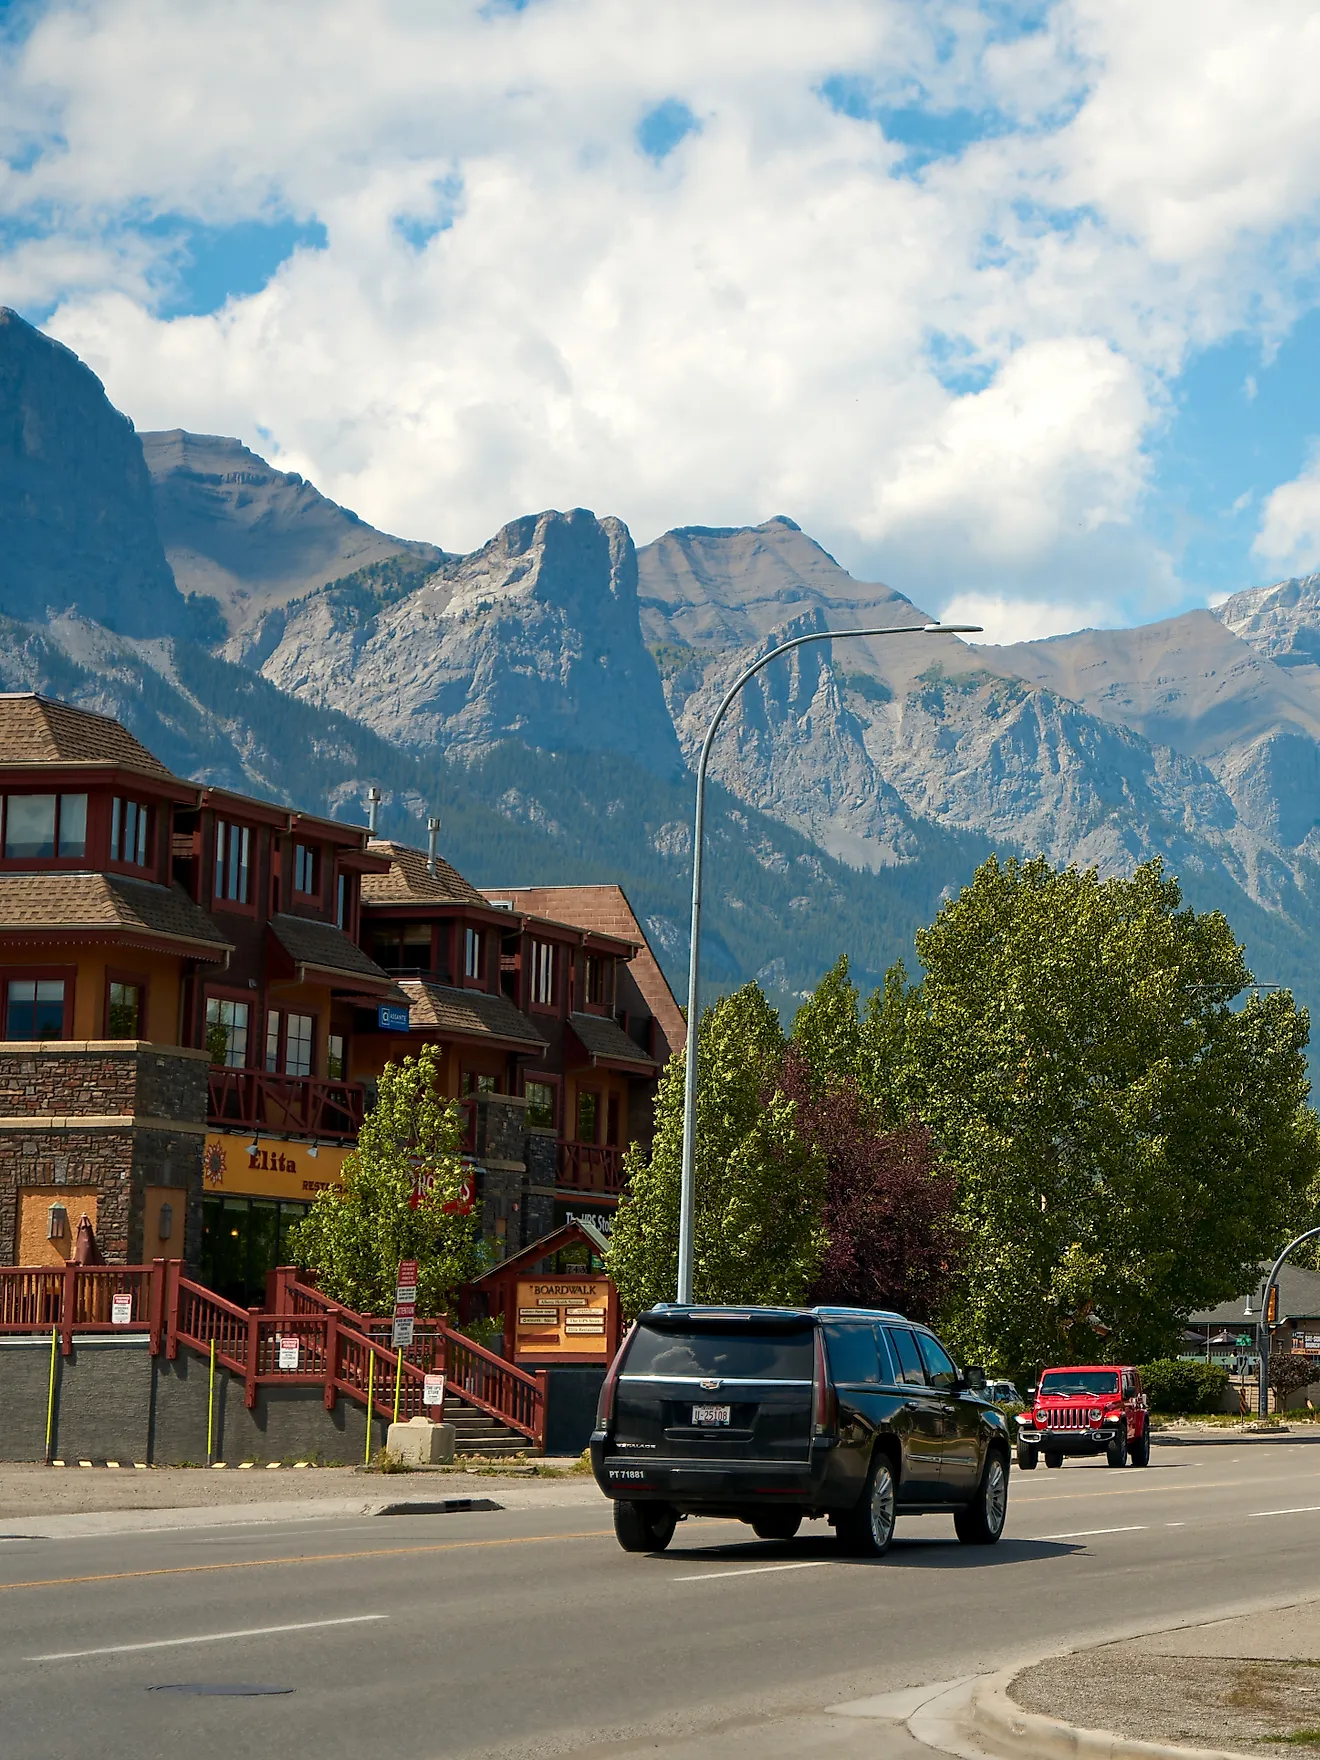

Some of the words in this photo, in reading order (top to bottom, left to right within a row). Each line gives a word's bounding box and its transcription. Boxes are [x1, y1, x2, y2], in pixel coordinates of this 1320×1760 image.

[248, 1150, 296, 1173] Elita
[566, 1212, 580, 1224] Th
[534, 1286, 596, 1294] BOARDWALK
[695, 1410, 728, 1421] U-25108
